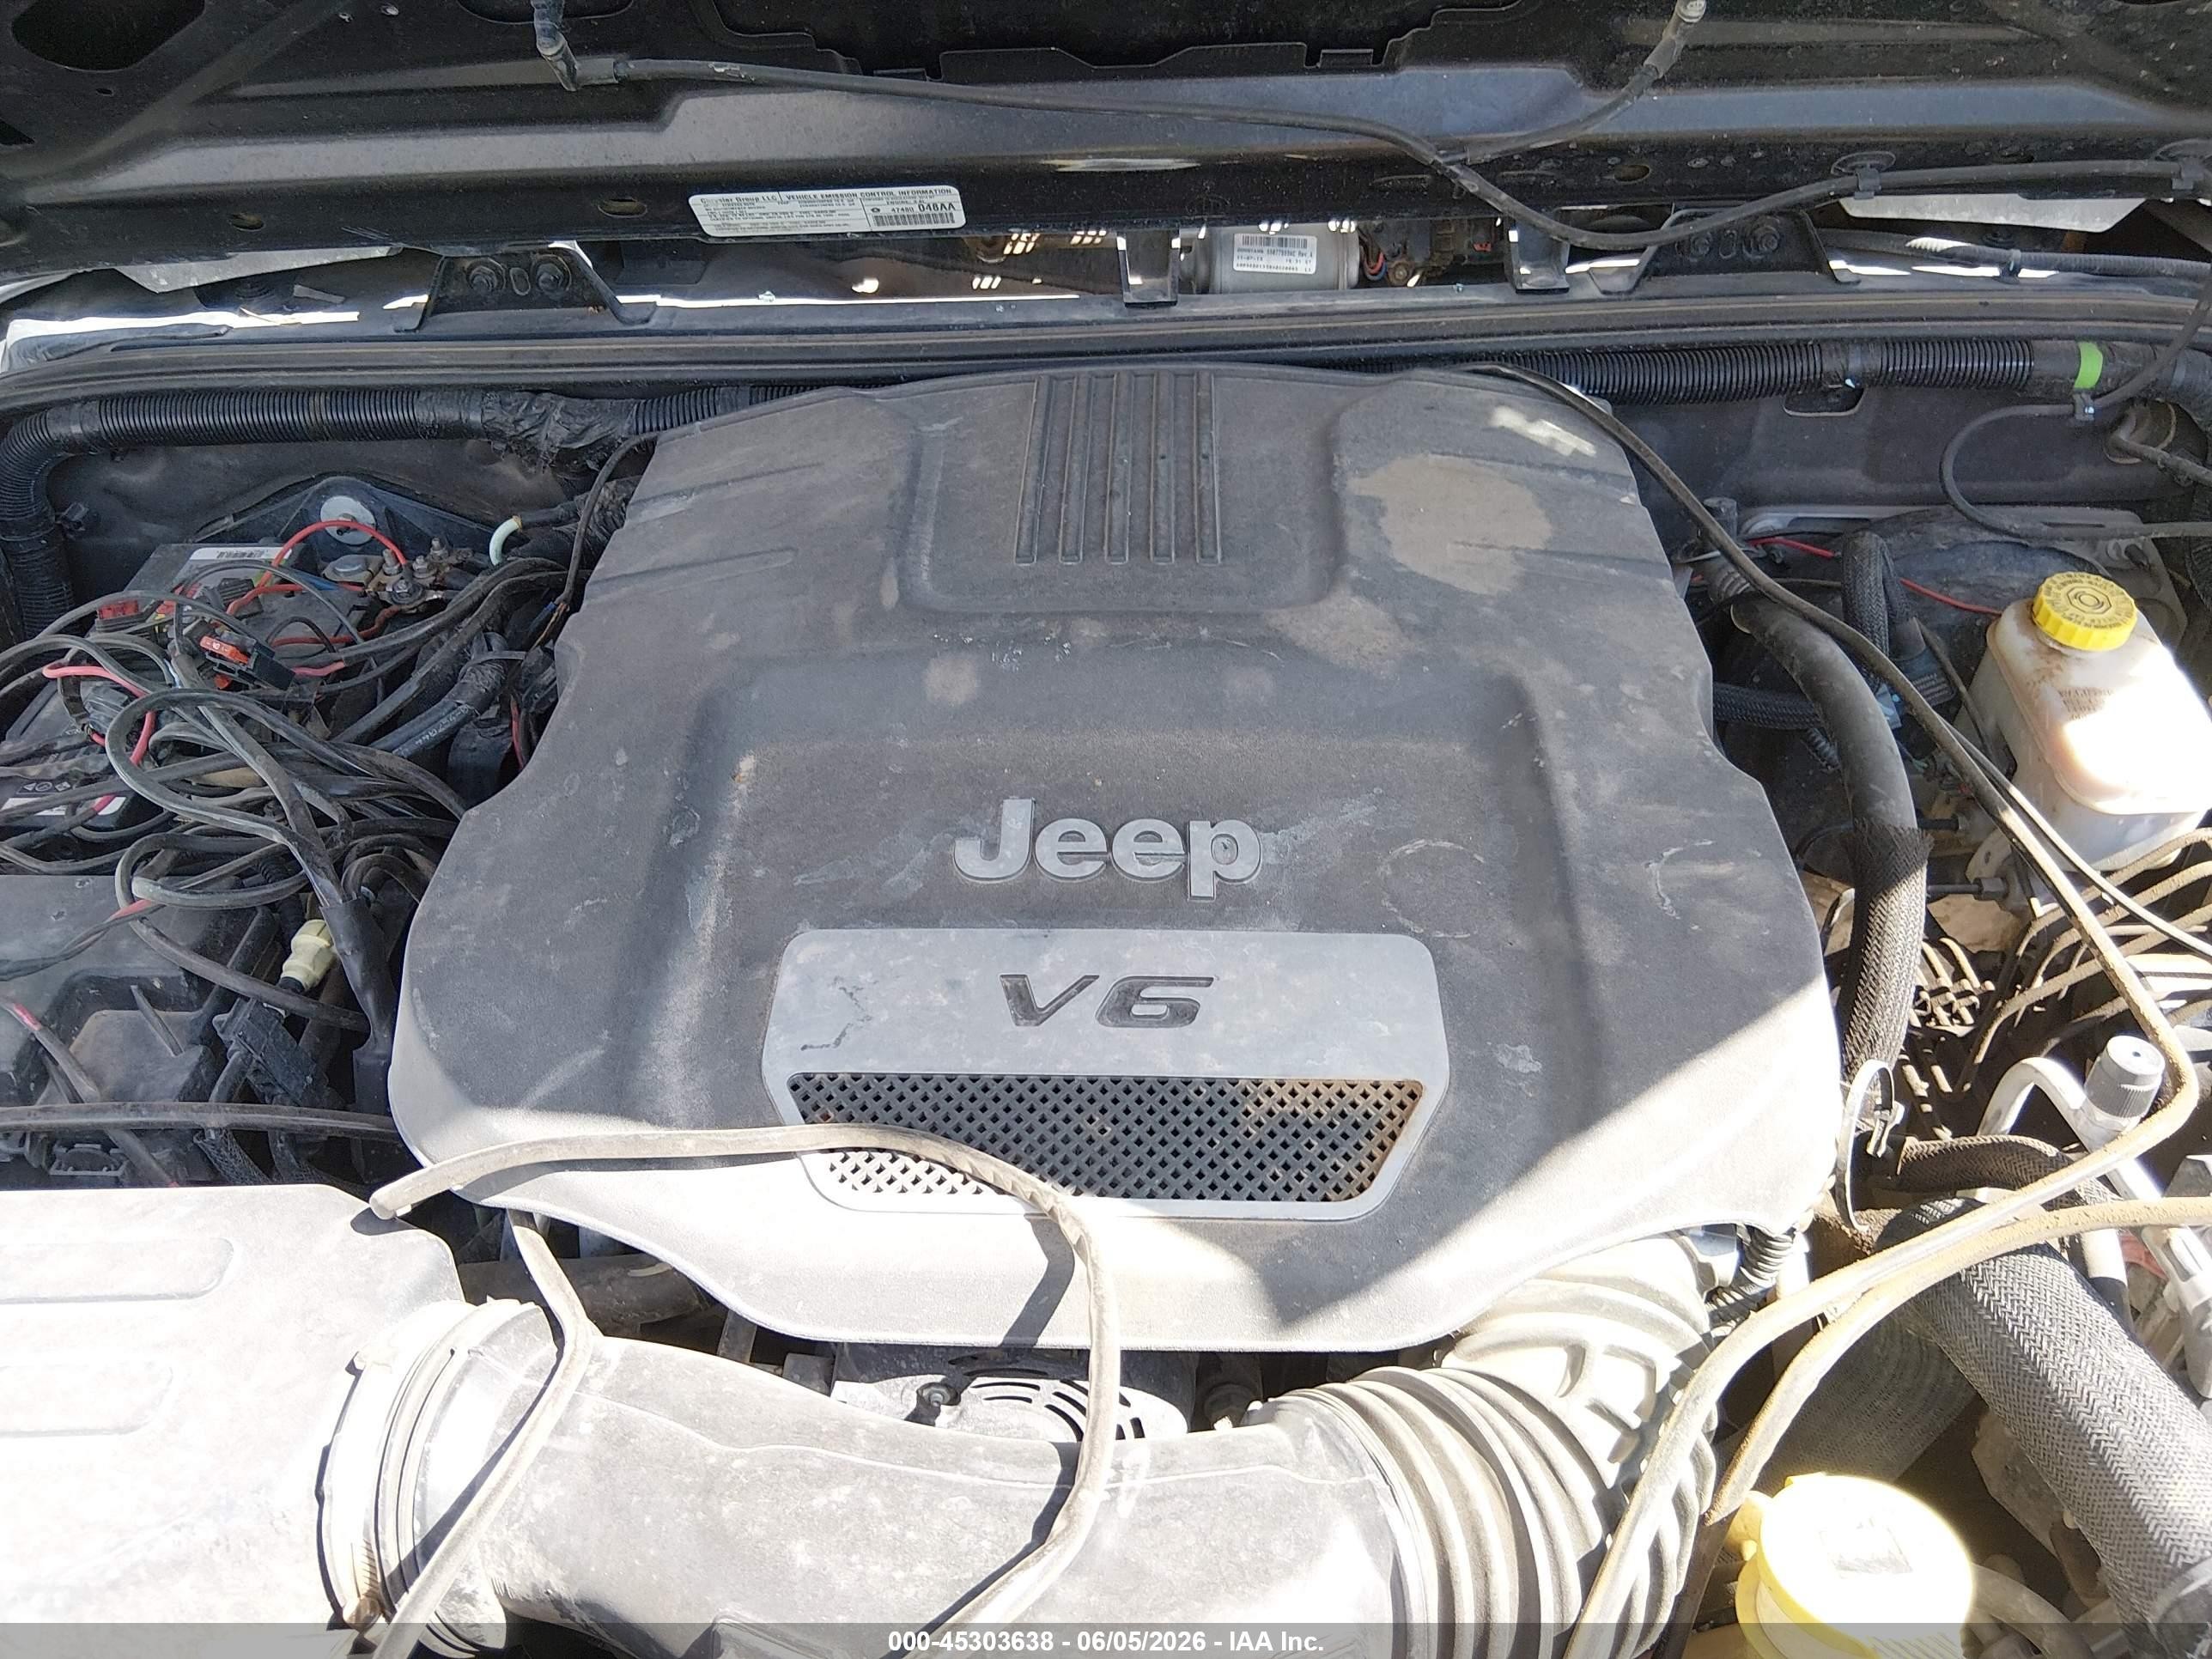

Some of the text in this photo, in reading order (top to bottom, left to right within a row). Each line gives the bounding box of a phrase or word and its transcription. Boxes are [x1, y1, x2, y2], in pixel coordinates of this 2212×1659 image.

[898, 188, 952, 197] INFORMATION
[954, 797, 1261, 900] Jeep
[1000, 974, 1215, 1029] V6
